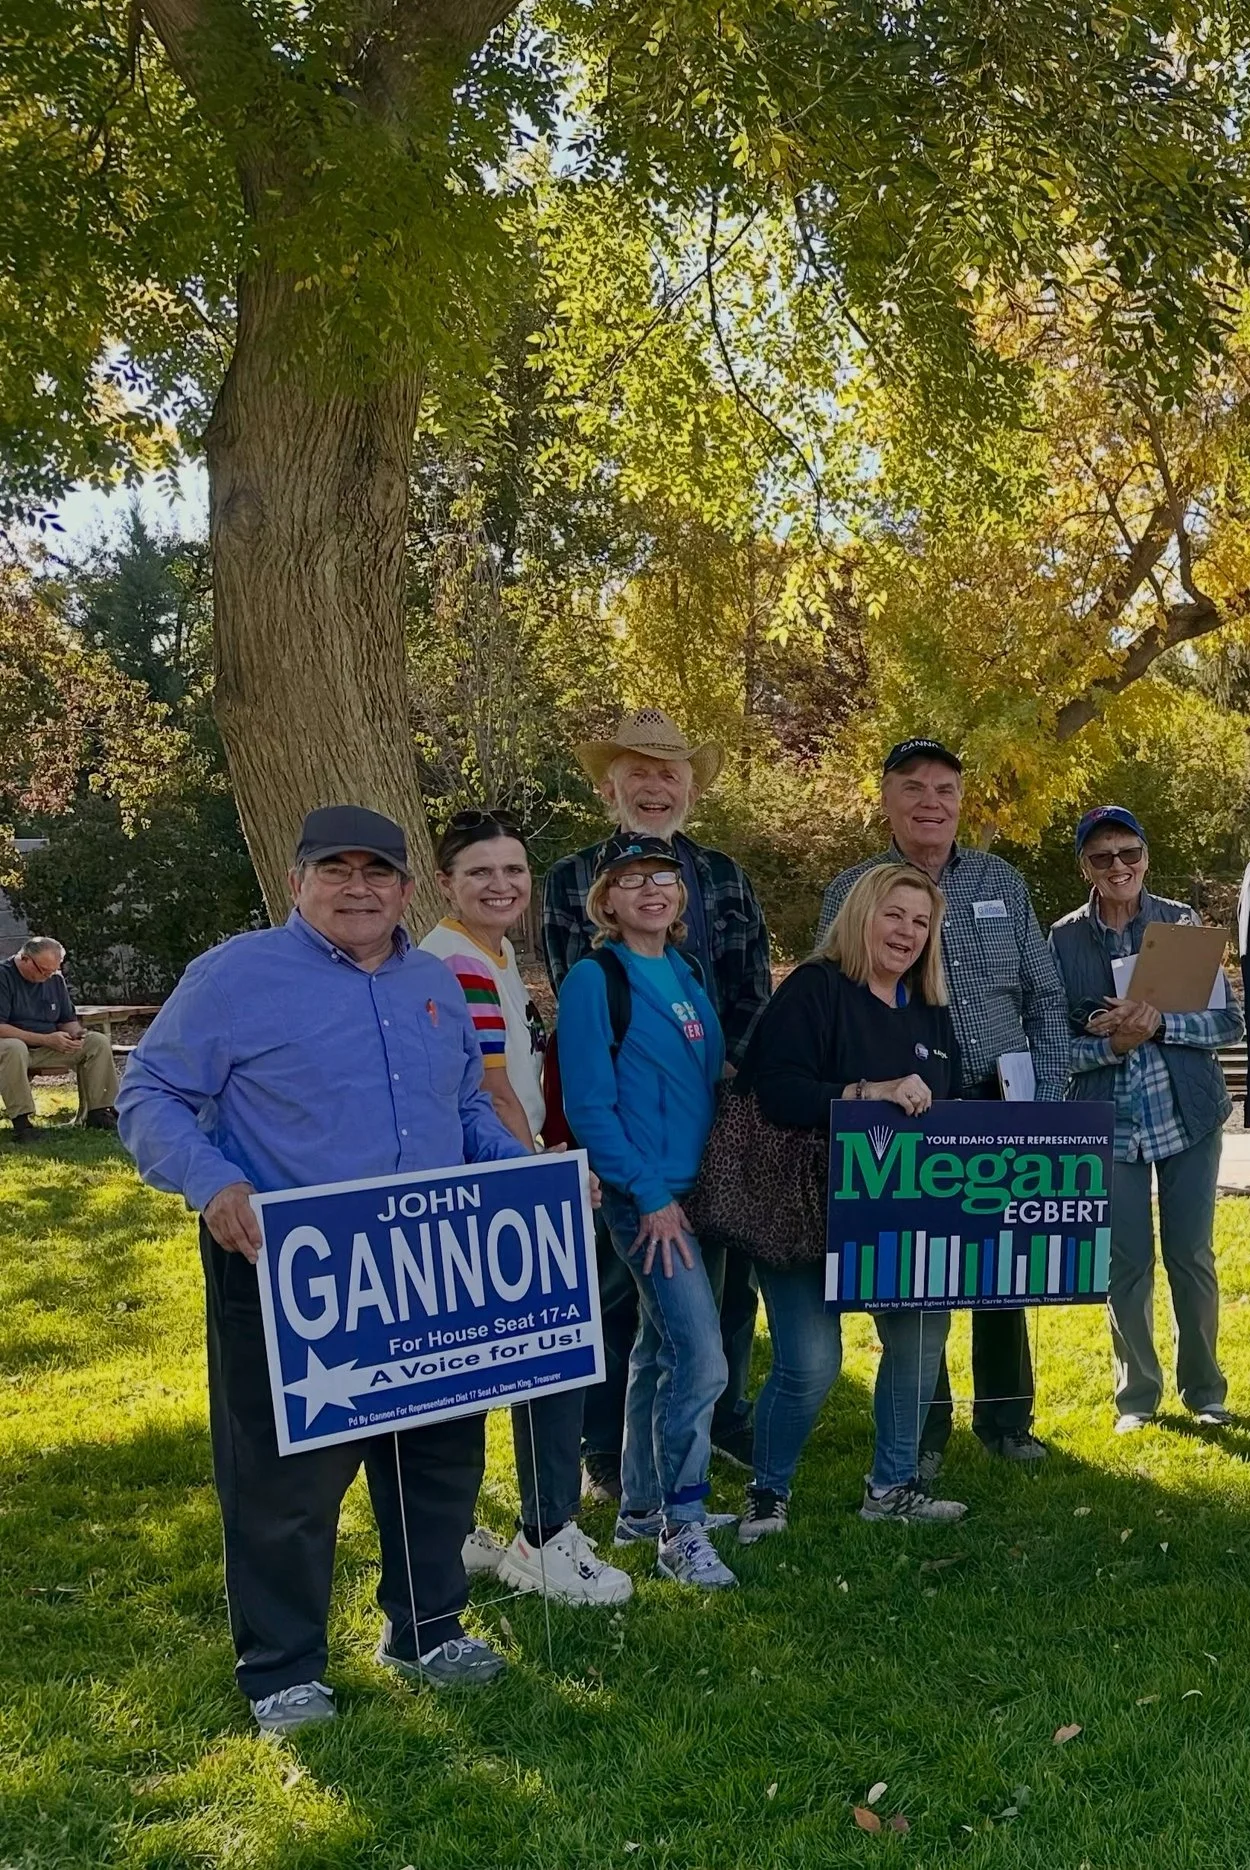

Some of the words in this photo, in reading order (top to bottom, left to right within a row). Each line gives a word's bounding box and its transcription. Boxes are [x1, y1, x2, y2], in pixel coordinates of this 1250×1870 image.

[926, 1135, 957, 1145] YOUR
[959, 1135, 995, 1145] IDAHO
[997, 1135, 1025, 1145] STATE
[1027, 1135, 1109, 1145] REPRESENTATIVE
[834, 1131, 1108, 1214] Megan
[377, 1184, 481, 1222] JOHN
[1003, 1200, 1109, 1224] EGBERT
[278, 1200, 579, 1341] GANNON
[389, 1337, 422, 1356] For
[428, 1324, 488, 1348] House
[494, 1312, 535, 1334] Seat
[540, 1304, 580, 1325] 17-A
[370, 1370, 393, 1387] A
[400, 1353, 480, 1379] Voice
[490, 1342, 529, 1361] for
[538, 1329, 581, 1350] Us!
[348, 1417, 358, 1427] Pd
[359, 1414, 368, 1425] By
[369, 1409, 396, 1422] Gannon
[396, 1406, 407, 1416] For
[408, 1395, 455, 1413] Representative
[455, 1392, 468, 1403] Dist
[469, 1390, 476, 1399] 17
[478, 1387, 491, 1397] Seat
[533, 1372, 561, 1384] Treasurer
